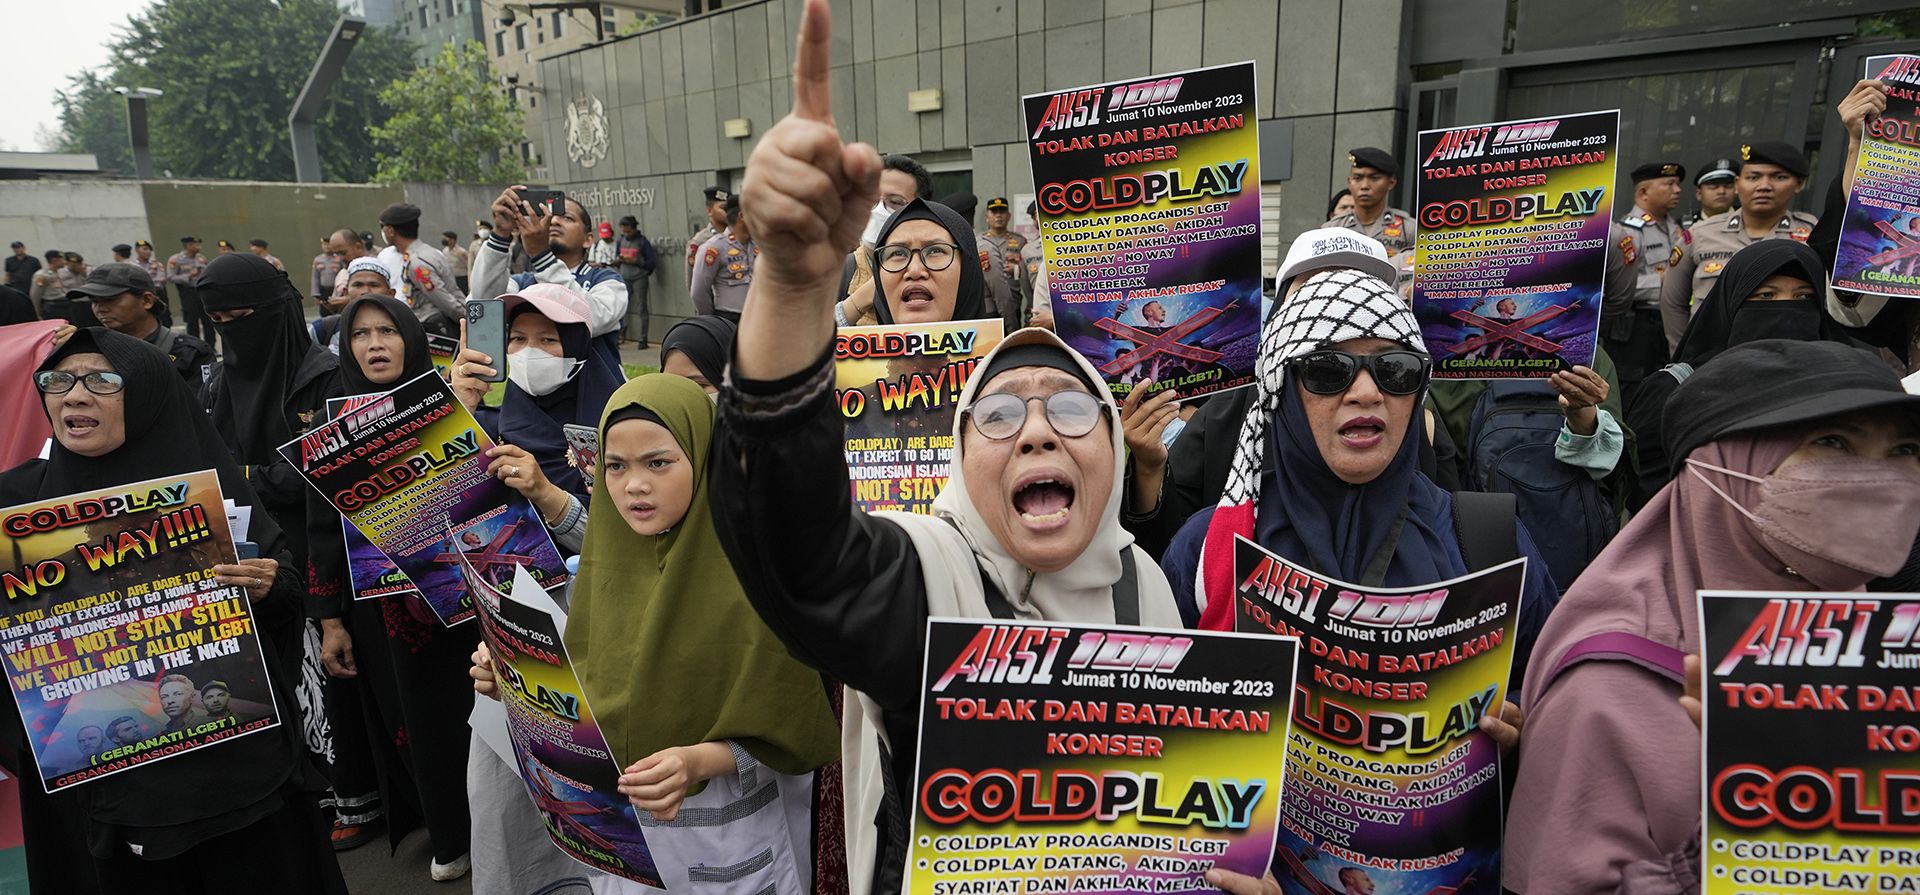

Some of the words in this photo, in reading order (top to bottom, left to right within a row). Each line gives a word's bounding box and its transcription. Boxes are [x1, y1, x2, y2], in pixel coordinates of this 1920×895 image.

[1033, 88, 1105, 140] AKSI
[1106, 110, 1139, 124] Jumat
[1142, 108, 1154, 118] 10
[1157, 99, 1213, 117] November
[1215, 94, 1243, 106] 2023
[1036, 134, 1094, 155] TOLAK
[1098, 129, 1137, 148] DAN
[1143, 114, 1244, 142] BATALKAN
[1423, 126, 1492, 167] AKSI
[1490, 146, 1518, 156] Jumat
[1521, 144, 1532, 152] 10
[1534, 139, 1580, 151] November
[1582, 135, 1607, 145] 2023
[1869, 141, 1908, 155] COLDPLAY
[1105, 146, 1177, 167] KONSER
[1425, 164, 1477, 180] TOLAK
[1481, 160, 1515, 174] DAN
[1519, 150, 1605, 170] BATALKAN
[1868, 151, 1908, 166] COLDPLAY
[570, 189, 600, 207] British
[605, 184, 655, 208] Embassy
[1038, 158, 1248, 215] COLDPLAY
[1483, 174, 1546, 190] KONSER
[1859, 187, 1879, 197] LGBT
[1881, 190, 1919, 205] MEREBAK
[1051, 216, 1111, 231] COLDPLAY
[1114, 207, 1195, 225] PROAGANDIS
[1198, 202, 1229, 215] LGBT
[1420, 186, 1604, 229] COLDPLAY
[1053, 228, 1112, 243] COLDPLAY
[1115, 224, 1168, 238] DATANG,
[1174, 216, 1223, 231] AKIDAH
[1055, 243, 1104, 255] SYARI'AT
[1107, 240, 1133, 251] DAN
[1135, 235, 1184, 247] AKHLAK
[1188, 225, 1256, 242] MELAYANG
[1427, 230, 1482, 242] COLDPLAY
[1485, 224, 1555, 237] PROAGANDIS
[1557, 220, 1585, 230] LGBT
[1427, 240, 1482, 251] COLDPLAY
[1484, 237, 1530, 247] DATANG,
[1536, 232, 1577, 242] AKIDAH
[1057, 270, 1079, 280] SAY
[1082, 269, 1097, 279] NO
[1100, 268, 1116, 277] TO
[1119, 265, 1149, 275] LGBT
[1059, 281, 1086, 292] LGBT
[1089, 277, 1145, 290] MEREBAK
[1838, 280, 1882, 294] GERAKAN
[1097, 292, 1122, 302] DAN
[1128, 286, 1177, 300] AKHLAK
[836, 329, 976, 359] COLDPLAY
[352, 426, 376, 442] Jumat
[376, 421, 387, 430] 10
[387, 402, 423, 427] November
[423, 392, 444, 407] 2023
[301, 423, 349, 471] AKSI
[309, 451, 357, 479] TOLAK
[354, 437, 386, 457] DAN
[384, 403, 454, 442] BATALKAN
[368, 437, 421, 467] KONSER
[864, 450, 900, 462] EXPECT
[904, 450, 916, 461] TO
[920, 449, 934, 461] GO
[907, 437, 926, 449] ARE
[930, 436, 954, 449] DARE
[334, 427, 479, 511] COLDPLAY
[856, 480, 892, 501] NOT
[2, 481, 188, 537] COLDPLAY
[2, 560, 66, 600] NO
[77, 504, 209, 572] WAY!!!!
[15, 609, 44, 624] YOU
[127, 584, 150, 598] ARE
[153, 576, 183, 592] DARE
[185, 571, 201, 583] TO
[1240, 555, 1329, 624] AKSI
[0, 624, 33, 640] THEN
[36, 615, 73, 631] DON'T
[76, 603, 121, 621] EXPECT
[127, 597, 142, 610] TO
[146, 593, 162, 605] GO
[165, 585, 195, 599] HOME
[1, 639, 25, 652] WE
[30, 632, 57, 645] ARE
[61, 611, 139, 640] INDONESIAN
[143, 598, 194, 620] ISLAMIC
[197, 586, 240, 604] PEOPLE
[1323, 619, 1376, 643] Jumat
[1381, 629, 1402, 644] 10
[1406, 614, 1478, 643] November
[1478, 602, 1508, 625] 2023
[8, 645, 67, 672] WILL
[73, 630, 118, 656] NOT
[128, 610, 183, 642] STAY
[193, 598, 247, 626] STILL
[529, 629, 553, 646] 2023
[1242, 596, 1306, 649] TOLAK
[1309, 635, 1369, 672] DAN
[1378, 627, 1505, 674] BATALKAN
[1712, 599, 1881, 676] AKSI
[11, 672, 47, 693] WE
[50, 656, 98, 682] WILL
[102, 645, 138, 668] NOT
[146, 629, 203, 657] ALLOW
[211, 619, 252, 641] LGBT
[39, 665, 131, 701] GROWING
[135, 658, 156, 677] IN
[161, 649, 194, 669] THE
[198, 637, 241, 662] NKRI
[931, 625, 1070, 692] AKSI
[1062, 671, 1115, 689] Jumat
[1120, 673, 1139, 689] 10
[1144, 675, 1229, 695] November
[1233, 680, 1274, 697] 2023
[1313, 665, 1428, 700] KONSER
[1719, 682, 1850, 711] TOLAK
[936, 697, 1035, 722] TOLAK
[1043, 700, 1107, 723] DAN
[1115, 703, 1271, 733] BATALKAN
[56, 759, 128, 787] GERAKAN
[130, 739, 202, 765] NASIONAL
[204, 730, 235, 744] ANTI
[237, 717, 271, 733] LGBT
[100, 730, 183, 762] GERANATI
[188, 719, 227, 738] LGBT
[1046, 733, 1163, 758] KONSER
[1316, 743, 1438, 776] PROAGANDIS
[1441, 740, 1471, 768] LGBT
[921, 768, 1266, 829] COLDPLAY
[935, 835, 1040, 852] COLDPLAY
[1044, 834, 1172, 850] PROAGANDIS
[1178, 839, 1228, 856] LGBT
[1732, 841, 1870, 864] COLDPLAY
[934, 856, 1038, 874] COLDPLAY
[1044, 855, 1126, 872] DATANG,
[1137, 857, 1214, 872] AKIDAH
[1732, 867, 1870, 892] COLDPLAY
[934, 880, 1020, 895] SYARI'AT
[1026, 878, 1074, 892] DAN
[1073, 876, 1150, 892] AKHLAK
